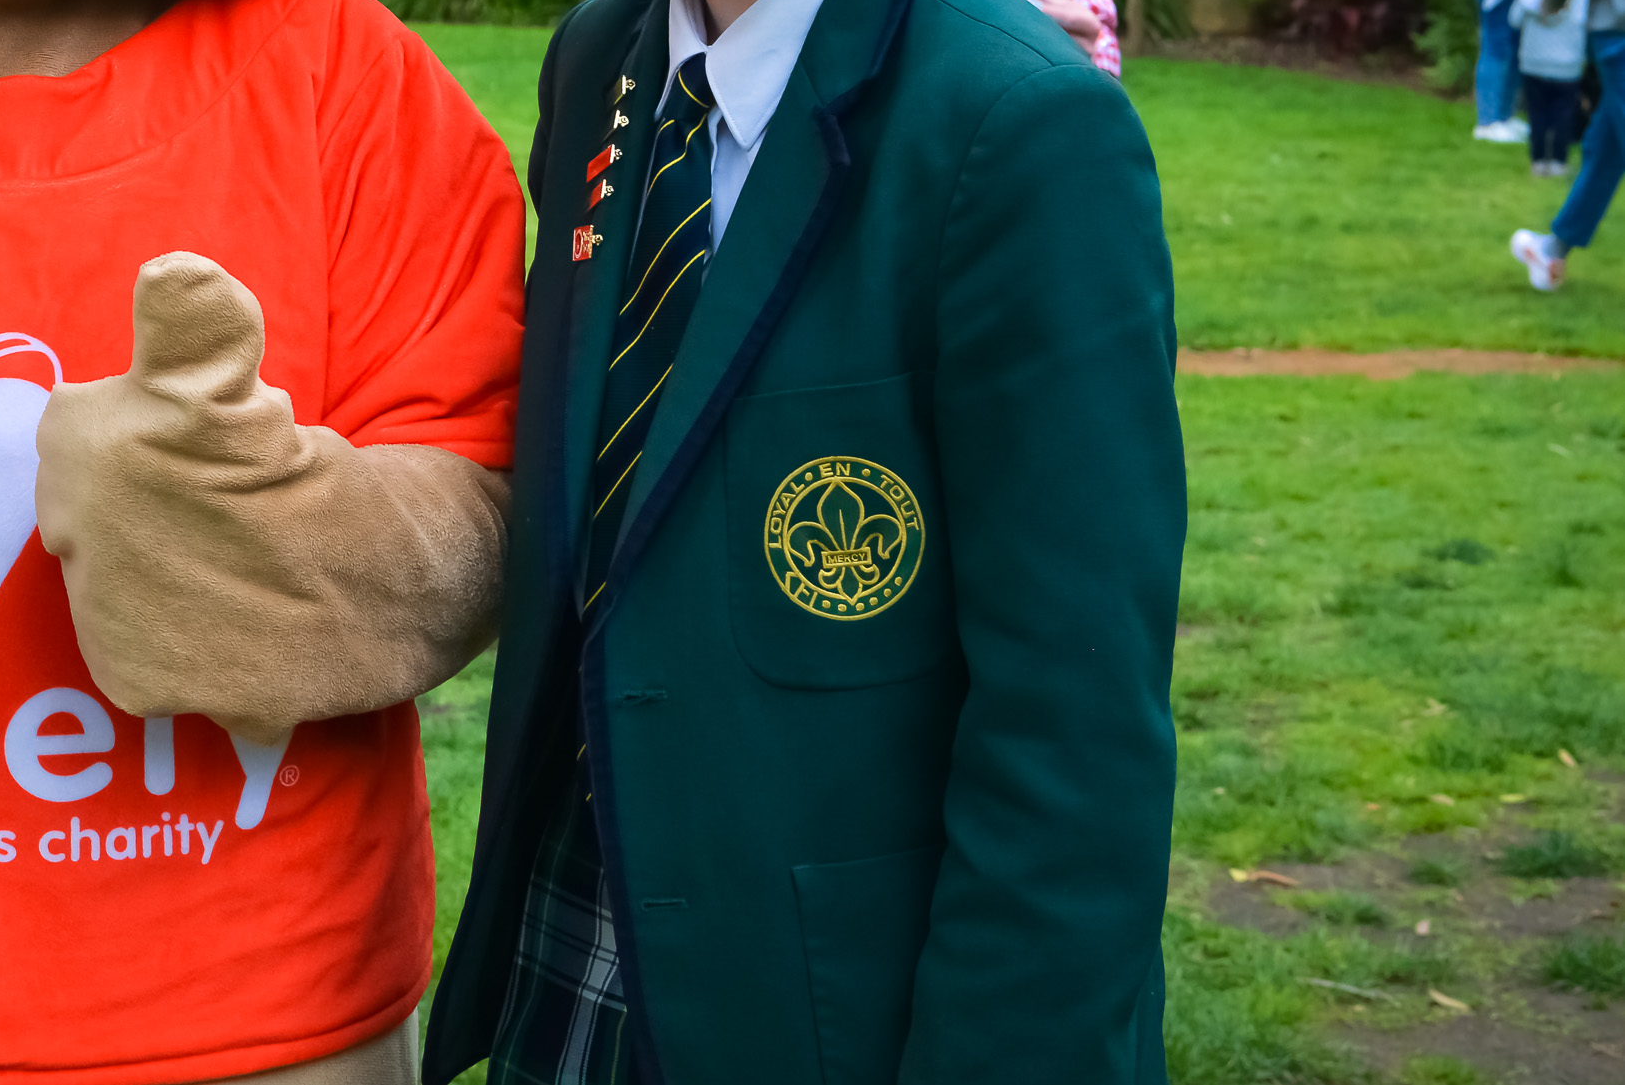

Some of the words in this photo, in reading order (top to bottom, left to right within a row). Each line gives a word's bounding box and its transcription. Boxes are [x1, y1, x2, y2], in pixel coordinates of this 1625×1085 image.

[769, 482, 805, 549] LOYAL
[819, 462, 851, 478] EN
[879, 474, 919, 531] TOUT
[827, 552, 866, 564] MERCY
[39, 811, 225, 866] charity
